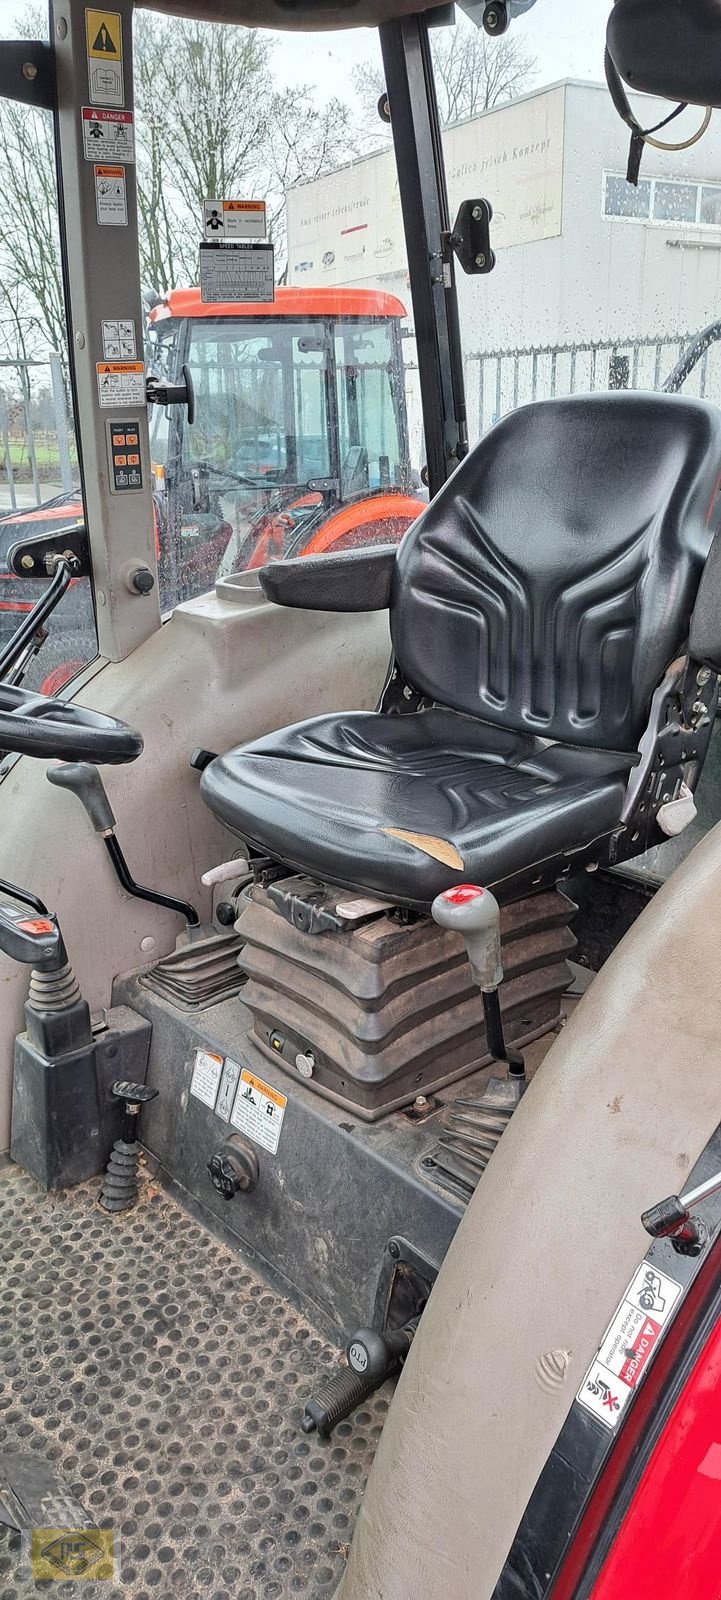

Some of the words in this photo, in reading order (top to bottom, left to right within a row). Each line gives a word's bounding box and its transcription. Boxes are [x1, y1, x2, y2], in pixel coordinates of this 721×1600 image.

[102, 112, 126, 121] DANGER
[511, 138, 552, 160] Konzept
[257, 1083, 279, 1102] WARNING
[620, 1308, 635, 1334] except
[633, 1313, 643, 1325] Do
[627, 1326, 635, 1339] not
[351, 1347, 367, 1367] PTO
[605, 1334, 622, 1366] operator
[623, 1338, 650, 1382] DANGER
